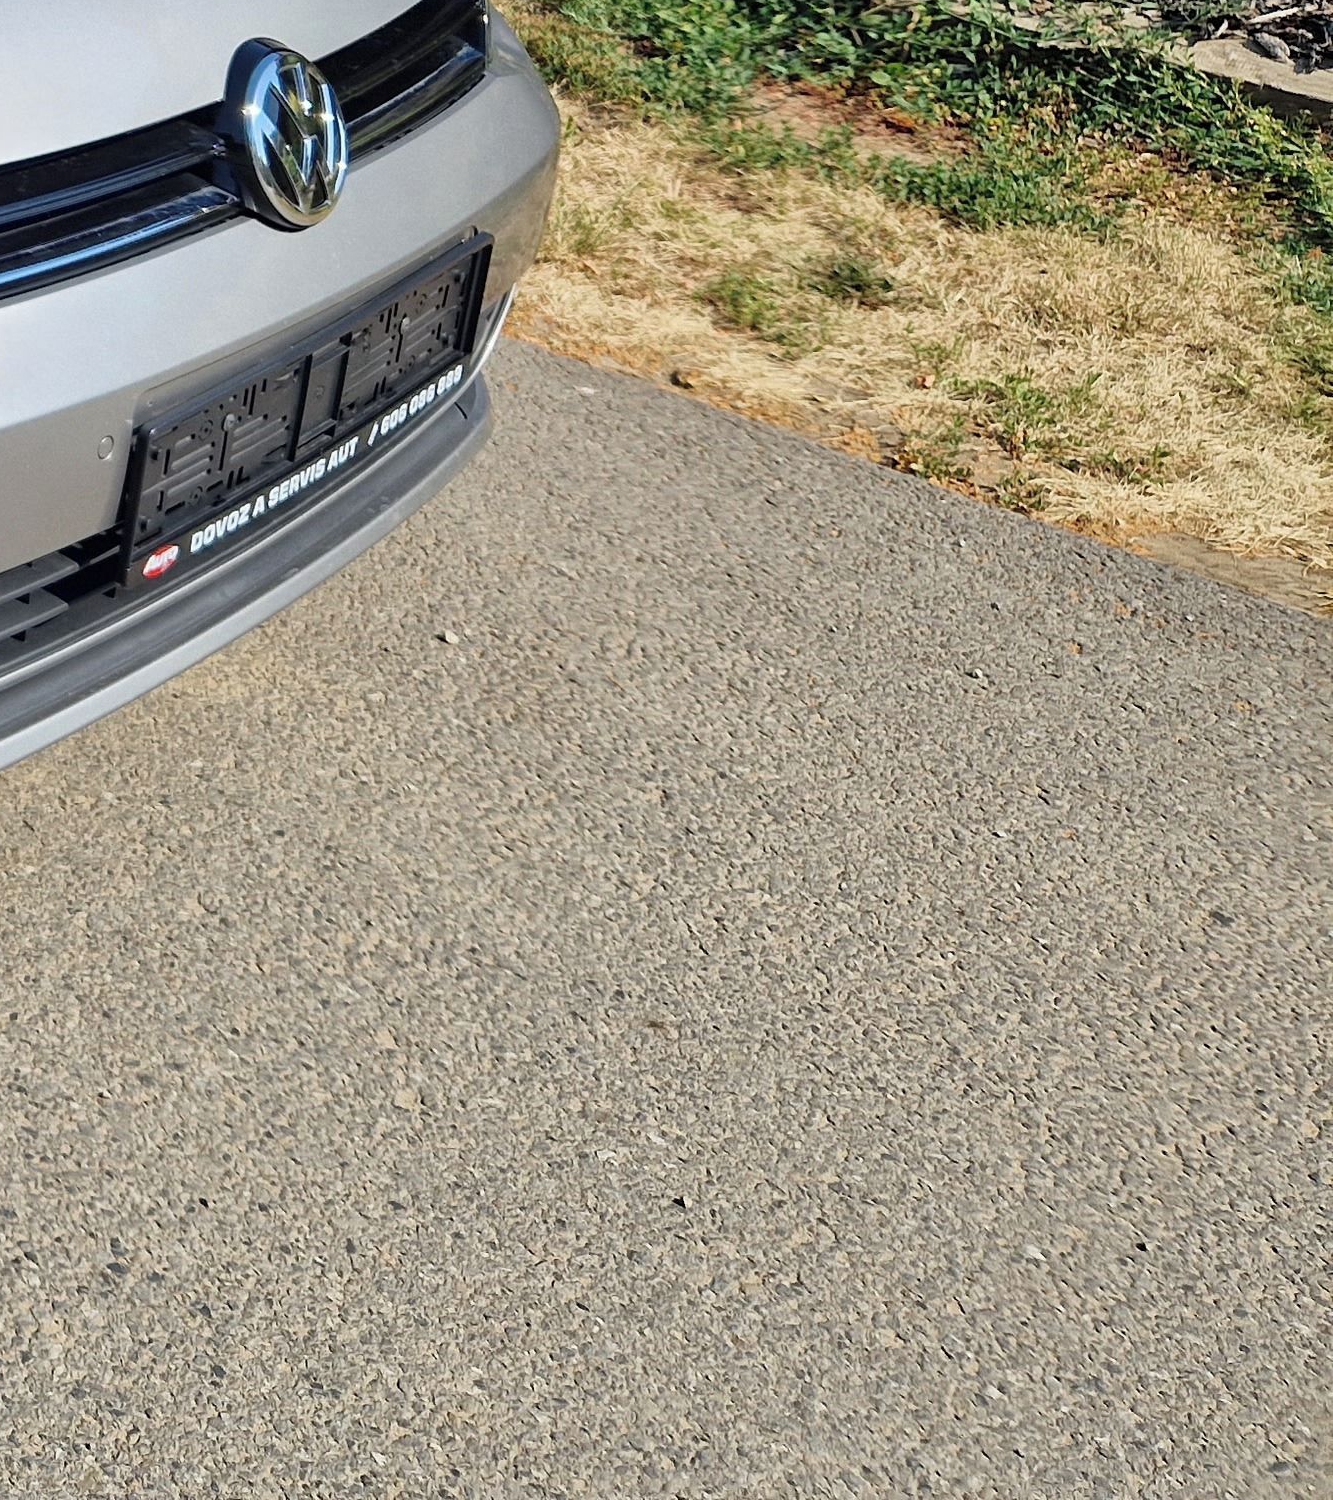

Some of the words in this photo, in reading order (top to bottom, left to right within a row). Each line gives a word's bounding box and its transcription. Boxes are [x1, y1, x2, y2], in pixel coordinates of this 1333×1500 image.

[190, 503, 252, 554] DOVOZ
[251, 495, 266, 518] A
[267, 458, 326, 509] SERVIS
[326, 436, 360, 472] AUT
